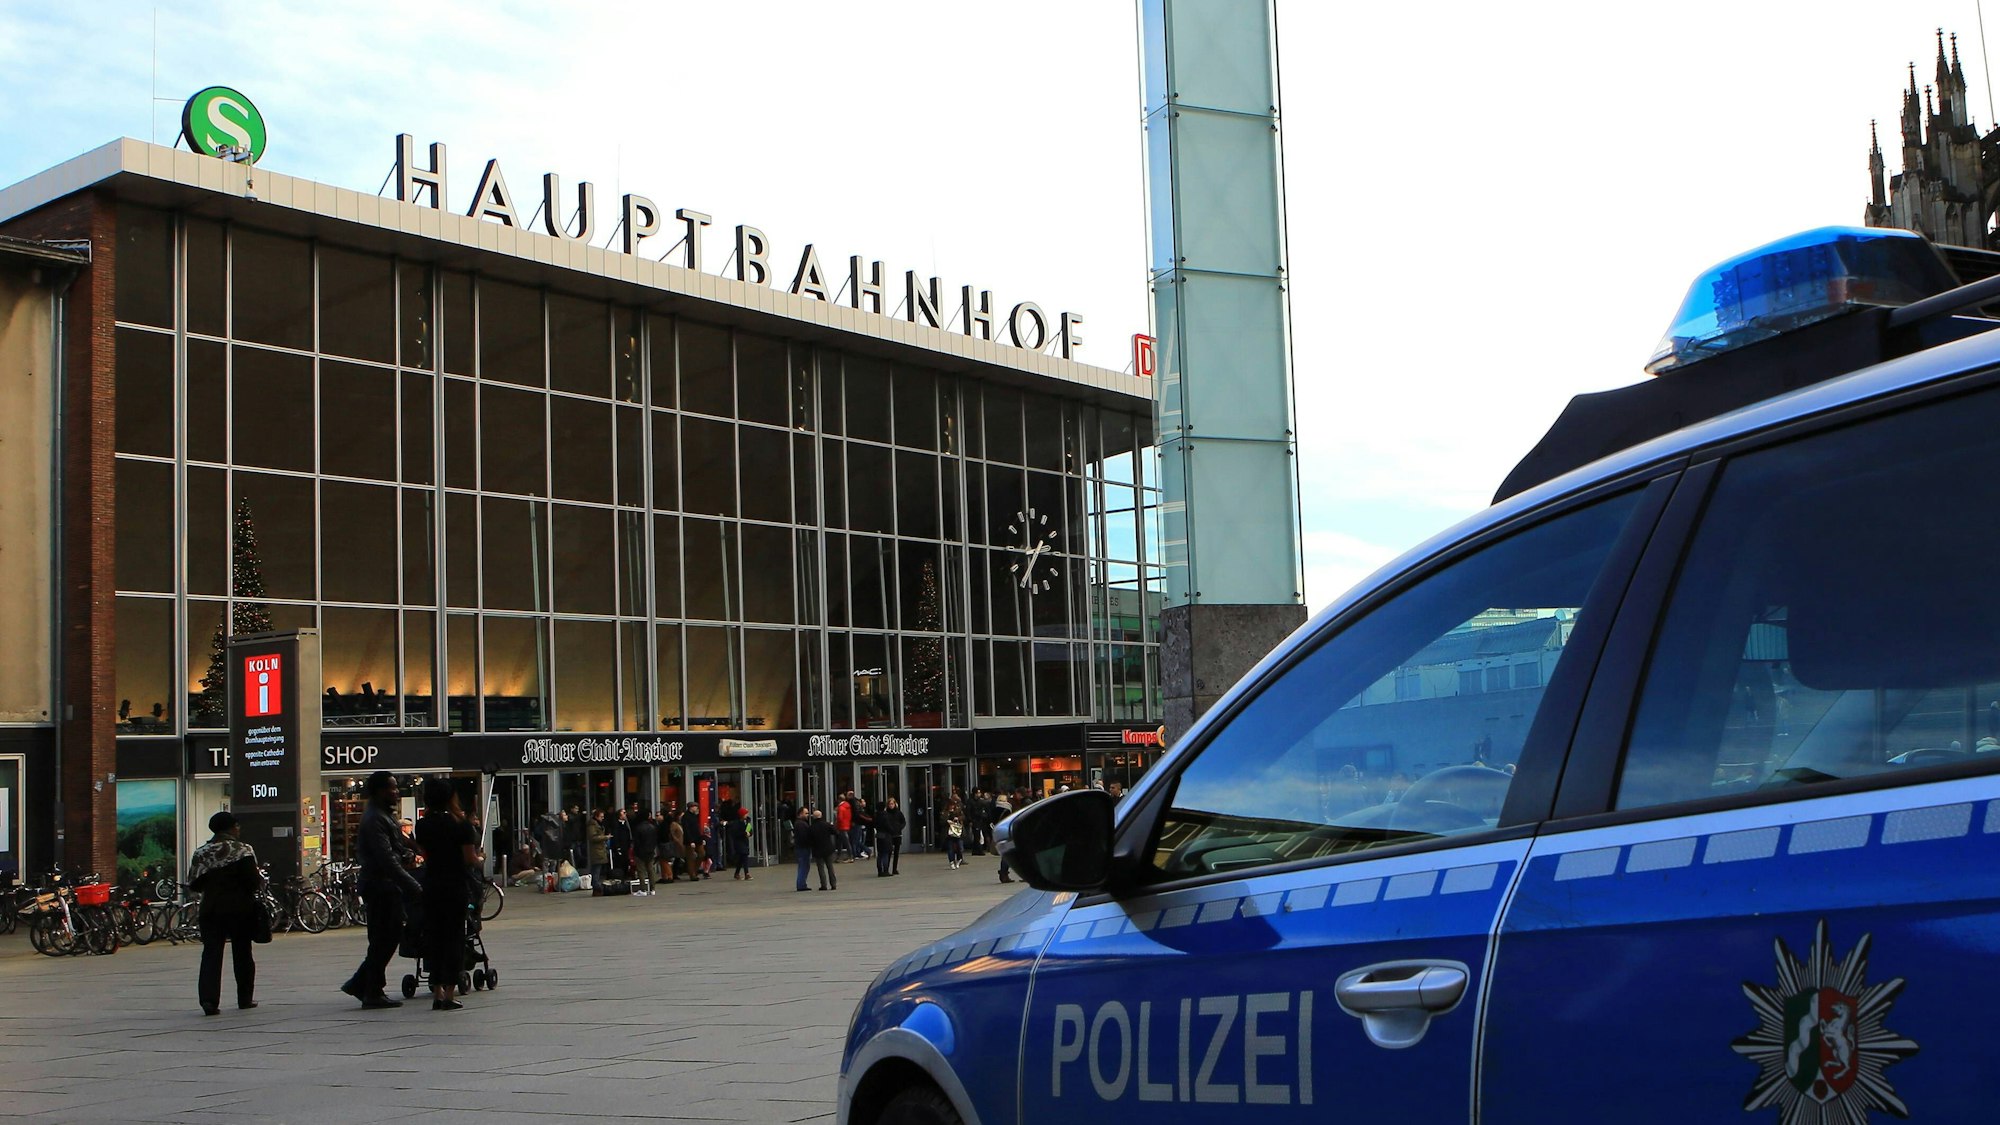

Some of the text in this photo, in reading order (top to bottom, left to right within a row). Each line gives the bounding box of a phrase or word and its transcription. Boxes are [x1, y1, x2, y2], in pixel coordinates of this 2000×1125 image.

[206, 96, 252, 154] S
[396, 133, 1084, 361] HAUPTBAHNHOF
[807, 734, 849, 757] Kölner
[1121, 728, 1158, 747] Kamps
[264, 748, 285, 757] Cathedral
[324, 745, 379, 765] SHOP
[521, 738, 577, 763] Kölner
[251, 783, 278, 798] 150 m
[1052, 990, 1314, 1105] POLIZEI
